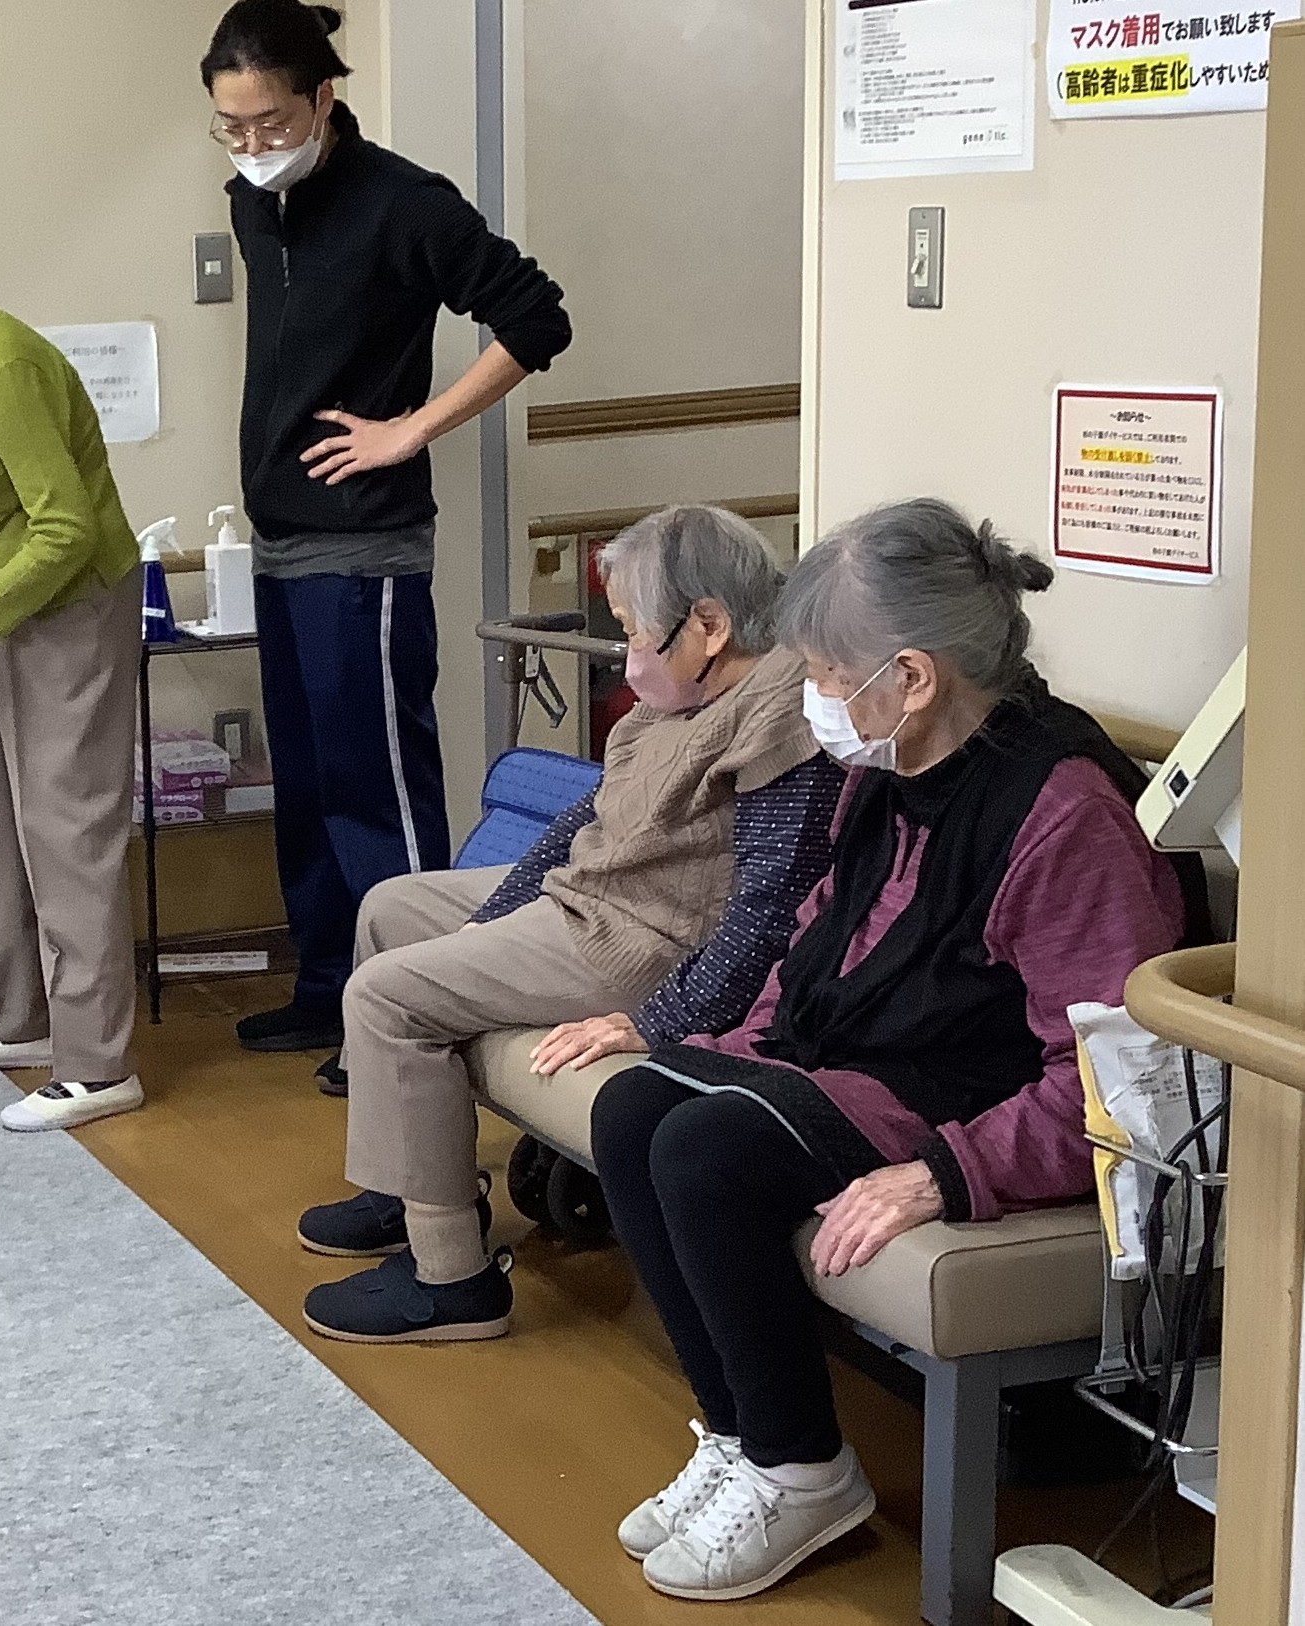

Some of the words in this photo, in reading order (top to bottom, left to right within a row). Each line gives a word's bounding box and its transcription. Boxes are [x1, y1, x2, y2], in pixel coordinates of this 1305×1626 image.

[1071, 9, 1276, 49] マスク着用でお願い致します
